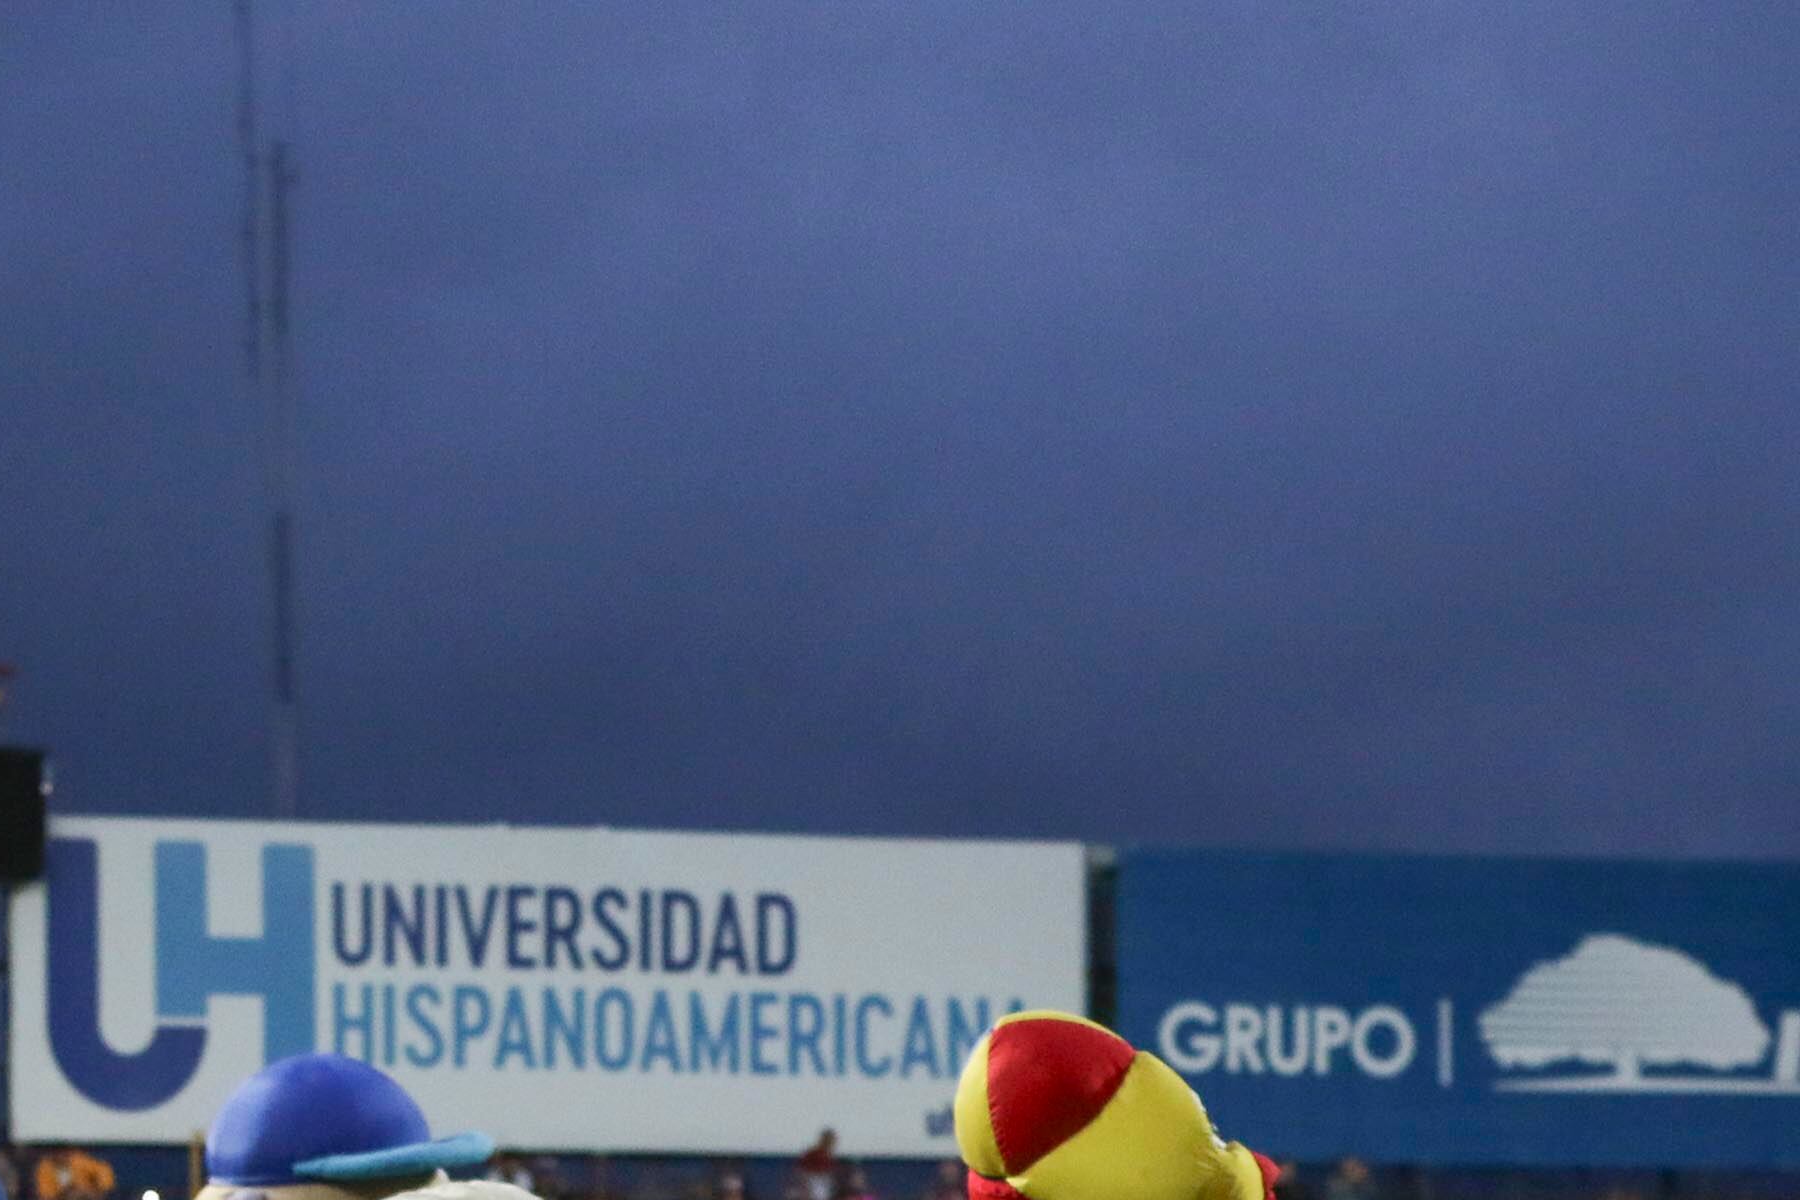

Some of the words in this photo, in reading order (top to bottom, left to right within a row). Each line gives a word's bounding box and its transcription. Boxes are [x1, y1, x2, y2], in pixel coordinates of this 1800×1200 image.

[331, 880, 798, 976] UNIVERSIDAD
[331, 982, 1026, 1080] HISPANOAMERICAN
[1157, 1001, 1417, 1078] GRUPO
